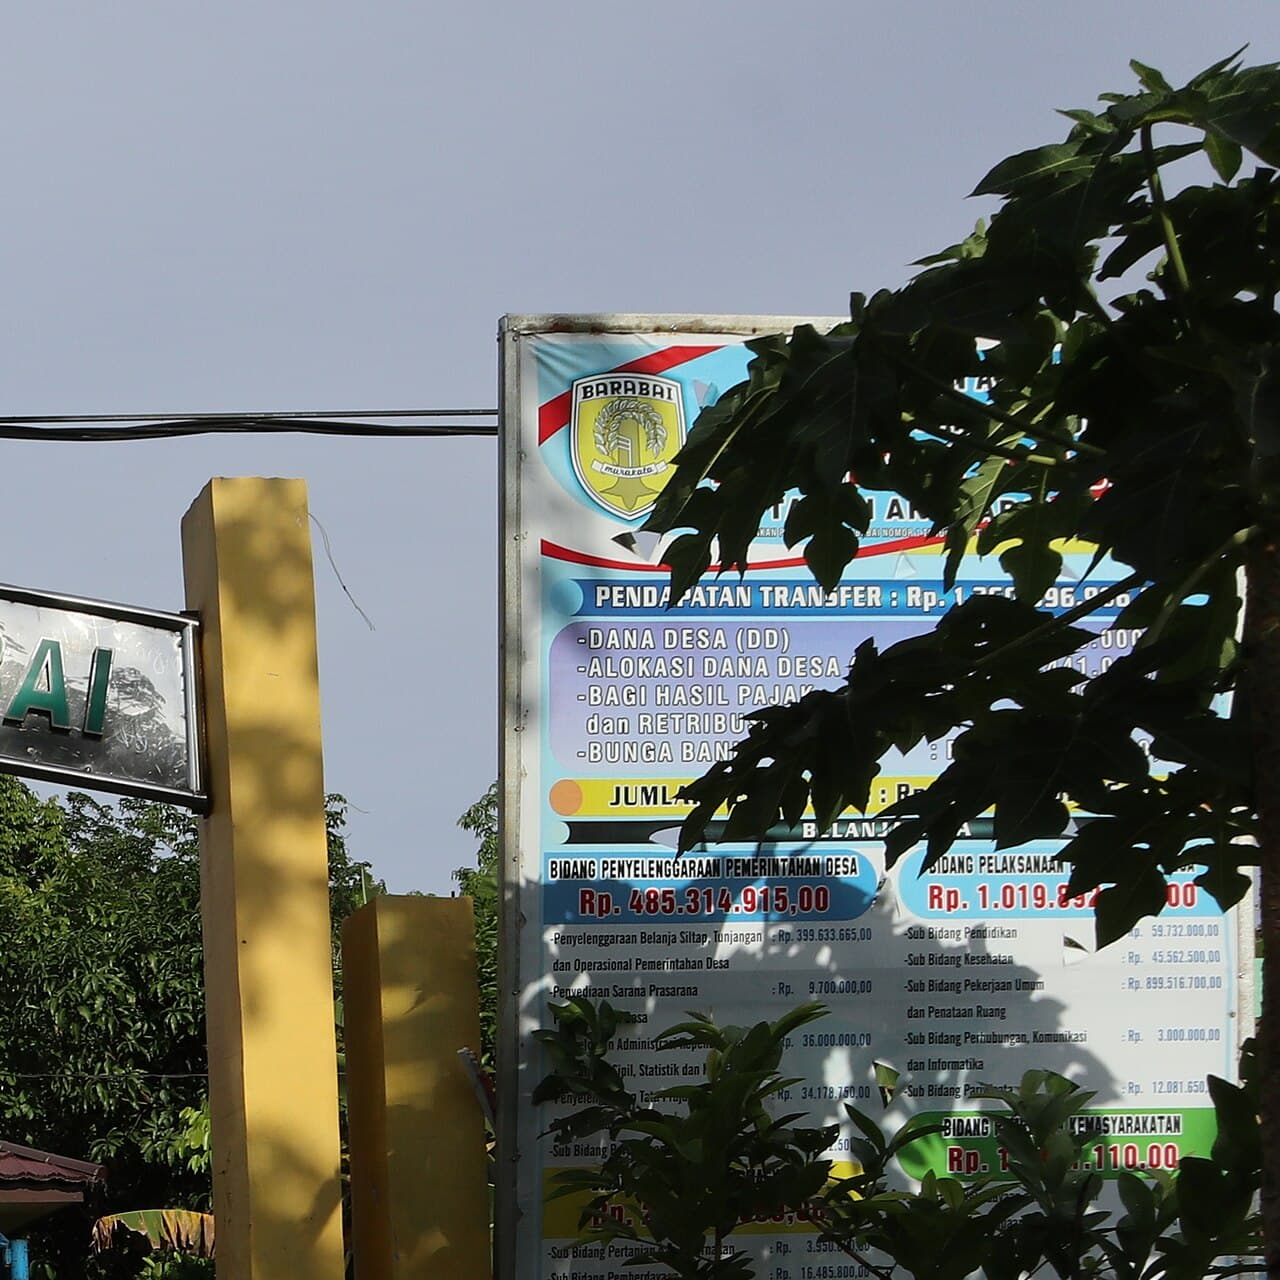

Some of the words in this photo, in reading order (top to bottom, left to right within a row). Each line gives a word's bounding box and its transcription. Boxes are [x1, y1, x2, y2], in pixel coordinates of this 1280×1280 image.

[582, 380, 673, 400] BARABAI
[906, 585, 945, 612] Rp.
[663, 629, 728, 649] DESA
[735, 627, 791, 652] (DD)
[702, 656, 770, 677] DANA
[777, 655, 841, 677] DESA
[655, 685, 730, 705] HASIL
[586, 713, 630, 735] dan
[549, 859, 596, 879] BIDANG
[601, 857, 721, 878] PENYELENGGARAAN
[726, 857, 821, 877] PEMERINTAHAN
[826, 857, 859, 876] DESA
[979, 856, 1065, 874] PELAKSANAAN
[579, 888, 620, 917] Rp.
[628, 886, 829, 915] 485.314.915,00
[928, 884, 968, 912] Rp.
[640, 930, 677, 946] Belanja
[713, 931, 763, 945] Tunjangan
[928, 926, 962, 941] Bidang
[964, 926, 1018, 940] Pendidikan
[553, 959, 573, 971] dan
[574, 958, 633, 973] Operasional
[635, 957, 703, 971] Pemerintahan
[706, 957, 730, 970] Desa
[928, 953, 962, 968] Bidang
[964, 953, 1014, 966] Kesehatan
[612, 985, 647, 998] Sarana
[649, 984, 698, 998] Prasarana
[928, 979, 962, 995] Bidang
[964, 979, 1013, 995] Pekerjaan
[1015, 979, 1045, 991] Umum
[907, 1006, 925, 1019] dan
[928, 1005, 973, 1018] Penataan
[976, 1005, 1006, 1020] Ruang
[928, 1033, 962, 1048] Bidang
[1032, 1031, 1088, 1044] Komunikasi
[640, 1063, 679, 1077] Statistik
[682, 1063, 700, 1076] dan
[907, 1059, 926, 1071] dan
[928, 1057, 984, 1071] Informatika
[927, 1084, 961, 1099] Bidang
[943, 1117, 989, 1137] BIDANG
[574, 1144, 608, 1160] Bidang
[948, 1147, 989, 1174] Rp.
[572, 1246, 605, 1260] Bidang
